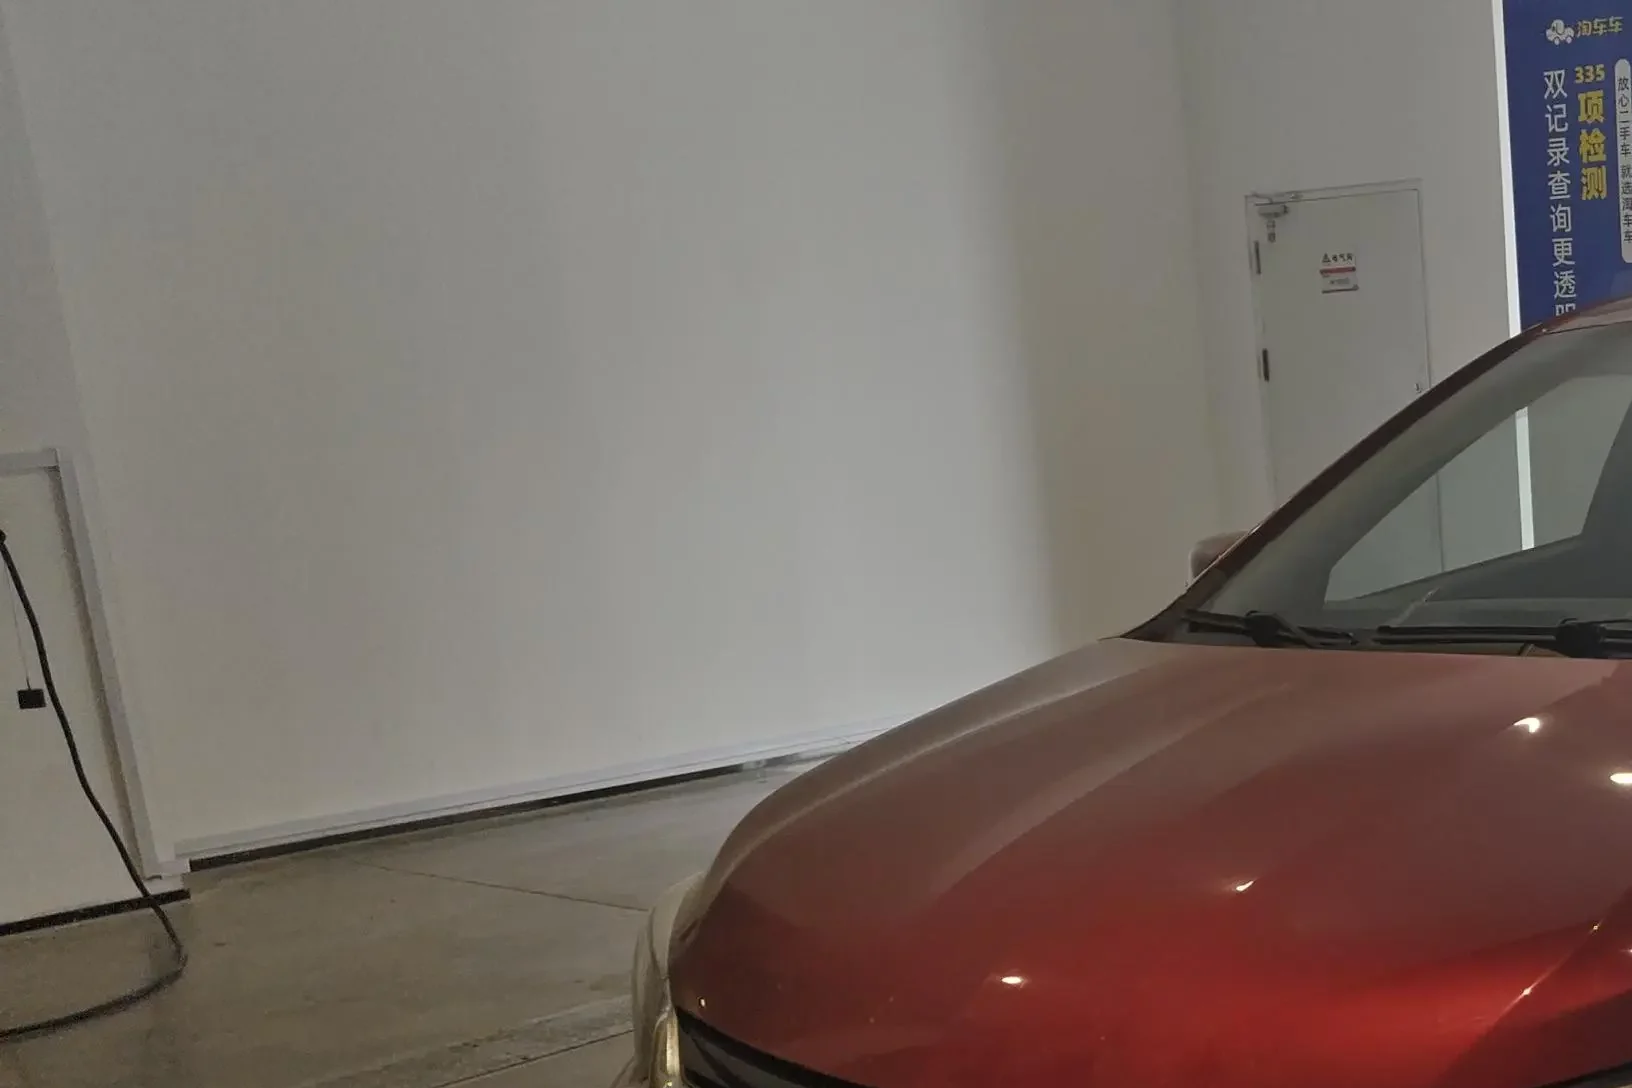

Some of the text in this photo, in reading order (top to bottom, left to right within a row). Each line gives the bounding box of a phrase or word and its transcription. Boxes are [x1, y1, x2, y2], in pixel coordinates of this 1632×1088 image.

[1577, 16, 1624, 37] 淘车车
[1617, 76, 1632, 157] 放心二手车
